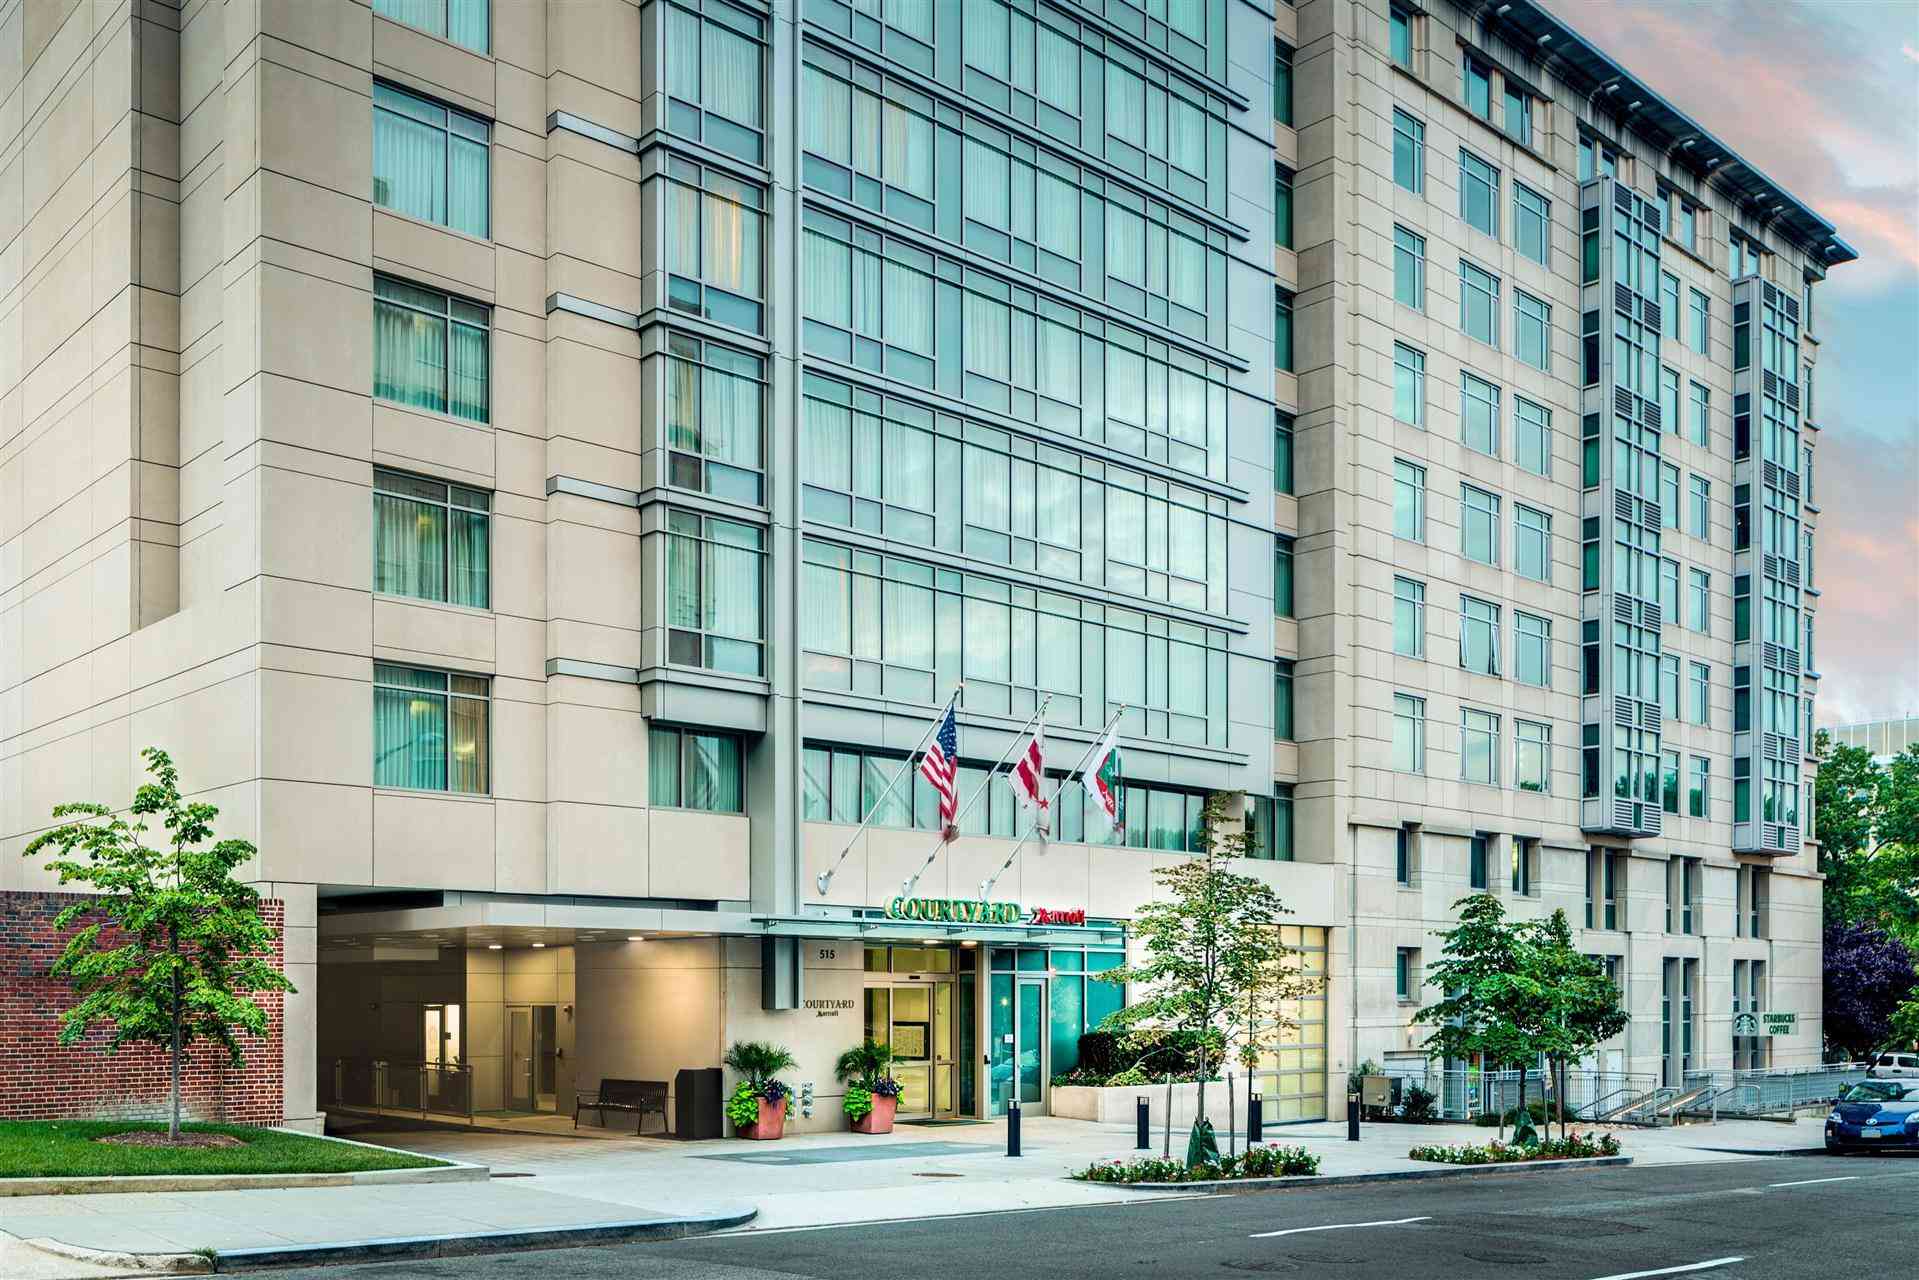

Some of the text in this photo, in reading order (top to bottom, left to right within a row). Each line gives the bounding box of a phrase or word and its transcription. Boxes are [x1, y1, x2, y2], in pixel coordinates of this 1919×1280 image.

[885, 896, 1021, 923] COURTYARD
[819, 949, 836, 960] 515
[1763, 1014, 1796, 1024] STARBUCKS
[1769, 1025, 1790, 1035] COFFEE
